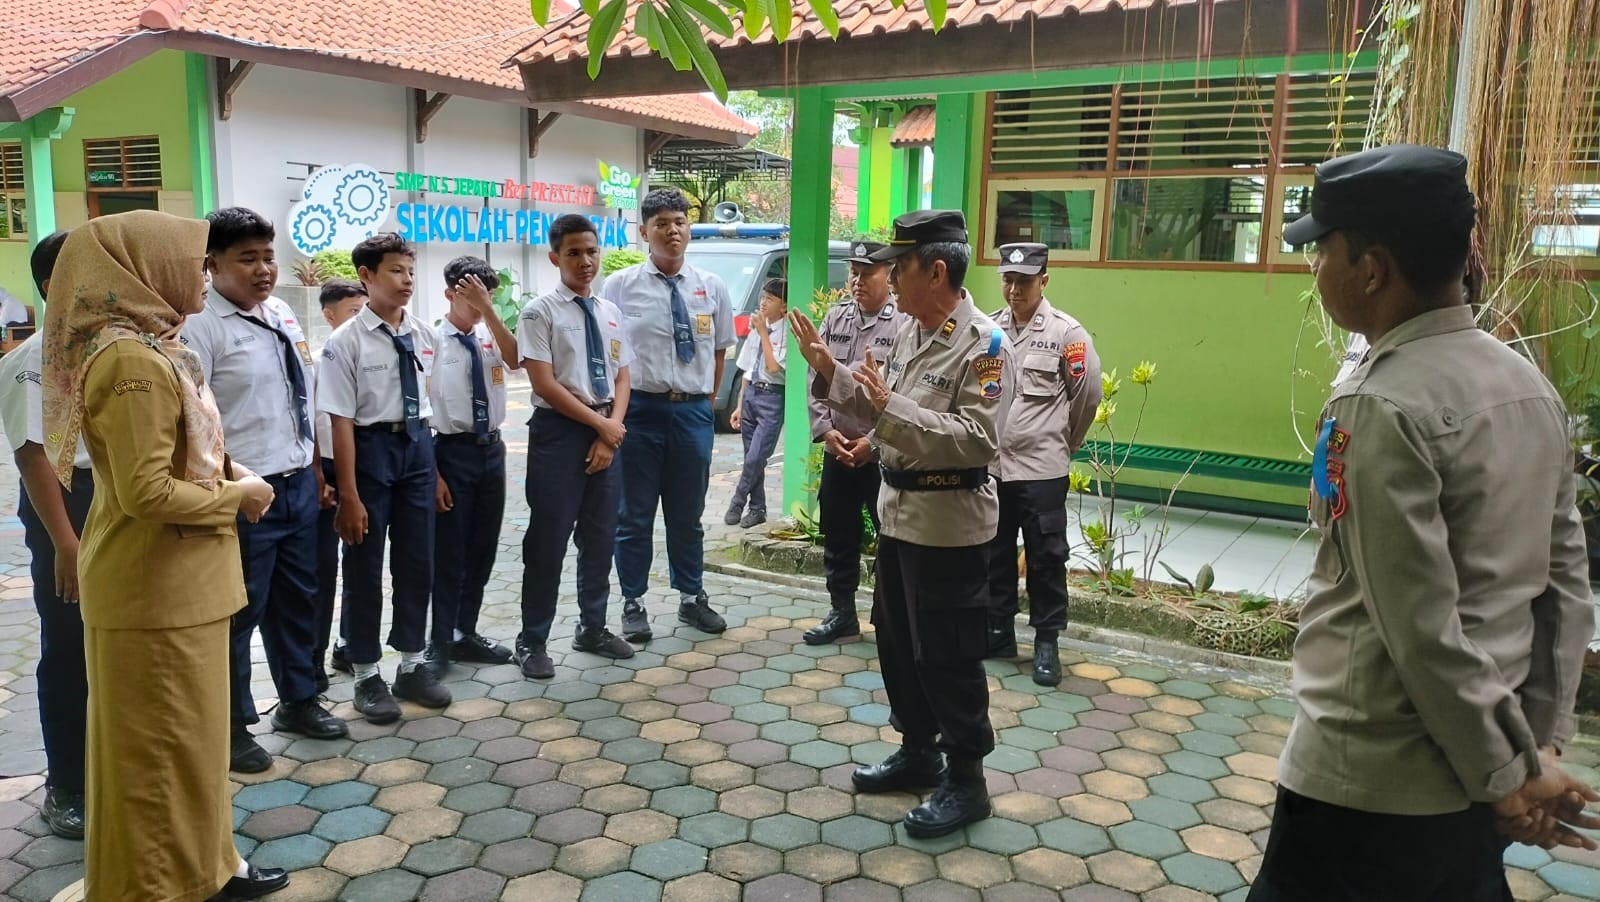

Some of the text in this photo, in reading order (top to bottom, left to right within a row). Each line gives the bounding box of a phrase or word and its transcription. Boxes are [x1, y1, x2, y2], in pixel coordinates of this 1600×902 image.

[395, 172, 424, 191] SMP
[453, 178, 497, 197] JEPARA
[609, 165, 631, 187] Go
[600, 181, 637, 199] Green
[396, 202, 629, 247] SEKOLAH PENRAK
[1030, 340, 1060, 351] POLRI
[922, 373, 950, 390] POLRI
[927, 474, 961, 486] POLISI
